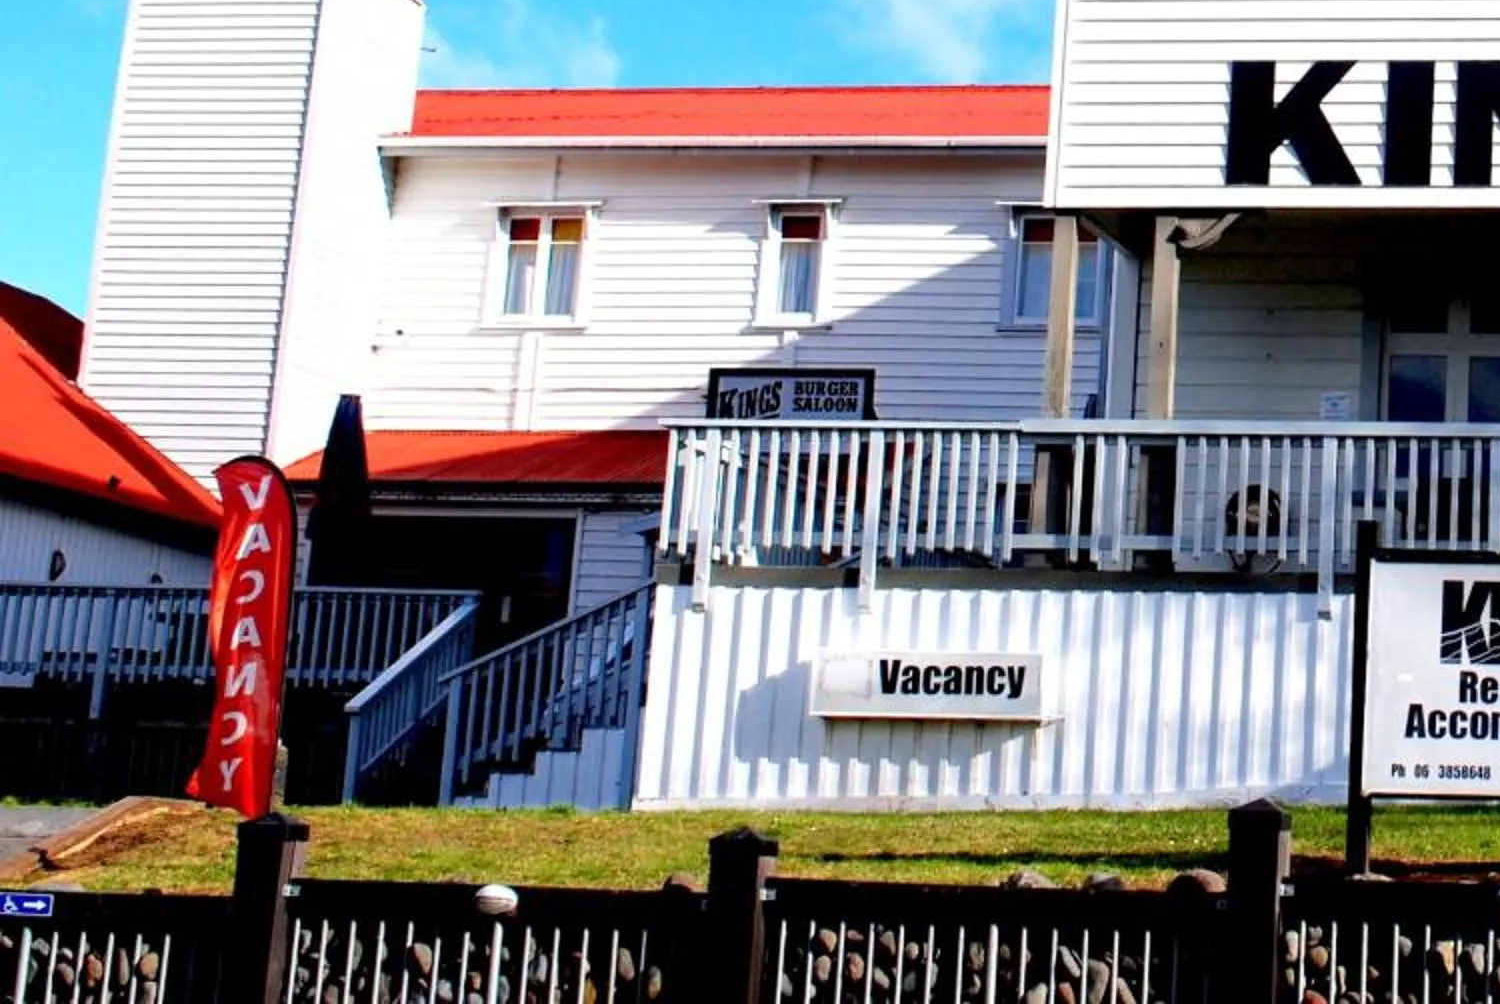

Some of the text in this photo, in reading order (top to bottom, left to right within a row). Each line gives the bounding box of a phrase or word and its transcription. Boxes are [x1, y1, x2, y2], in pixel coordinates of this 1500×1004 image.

[793, 381, 859, 395] BURGER
[718, 380, 783, 419] KINGS
[792, 398, 858, 413] SALOON
[879, 659, 1026, 699] Vacancy
[1391, 763, 1406, 777] Ph
[1414, 764, 1430, 779] 06
